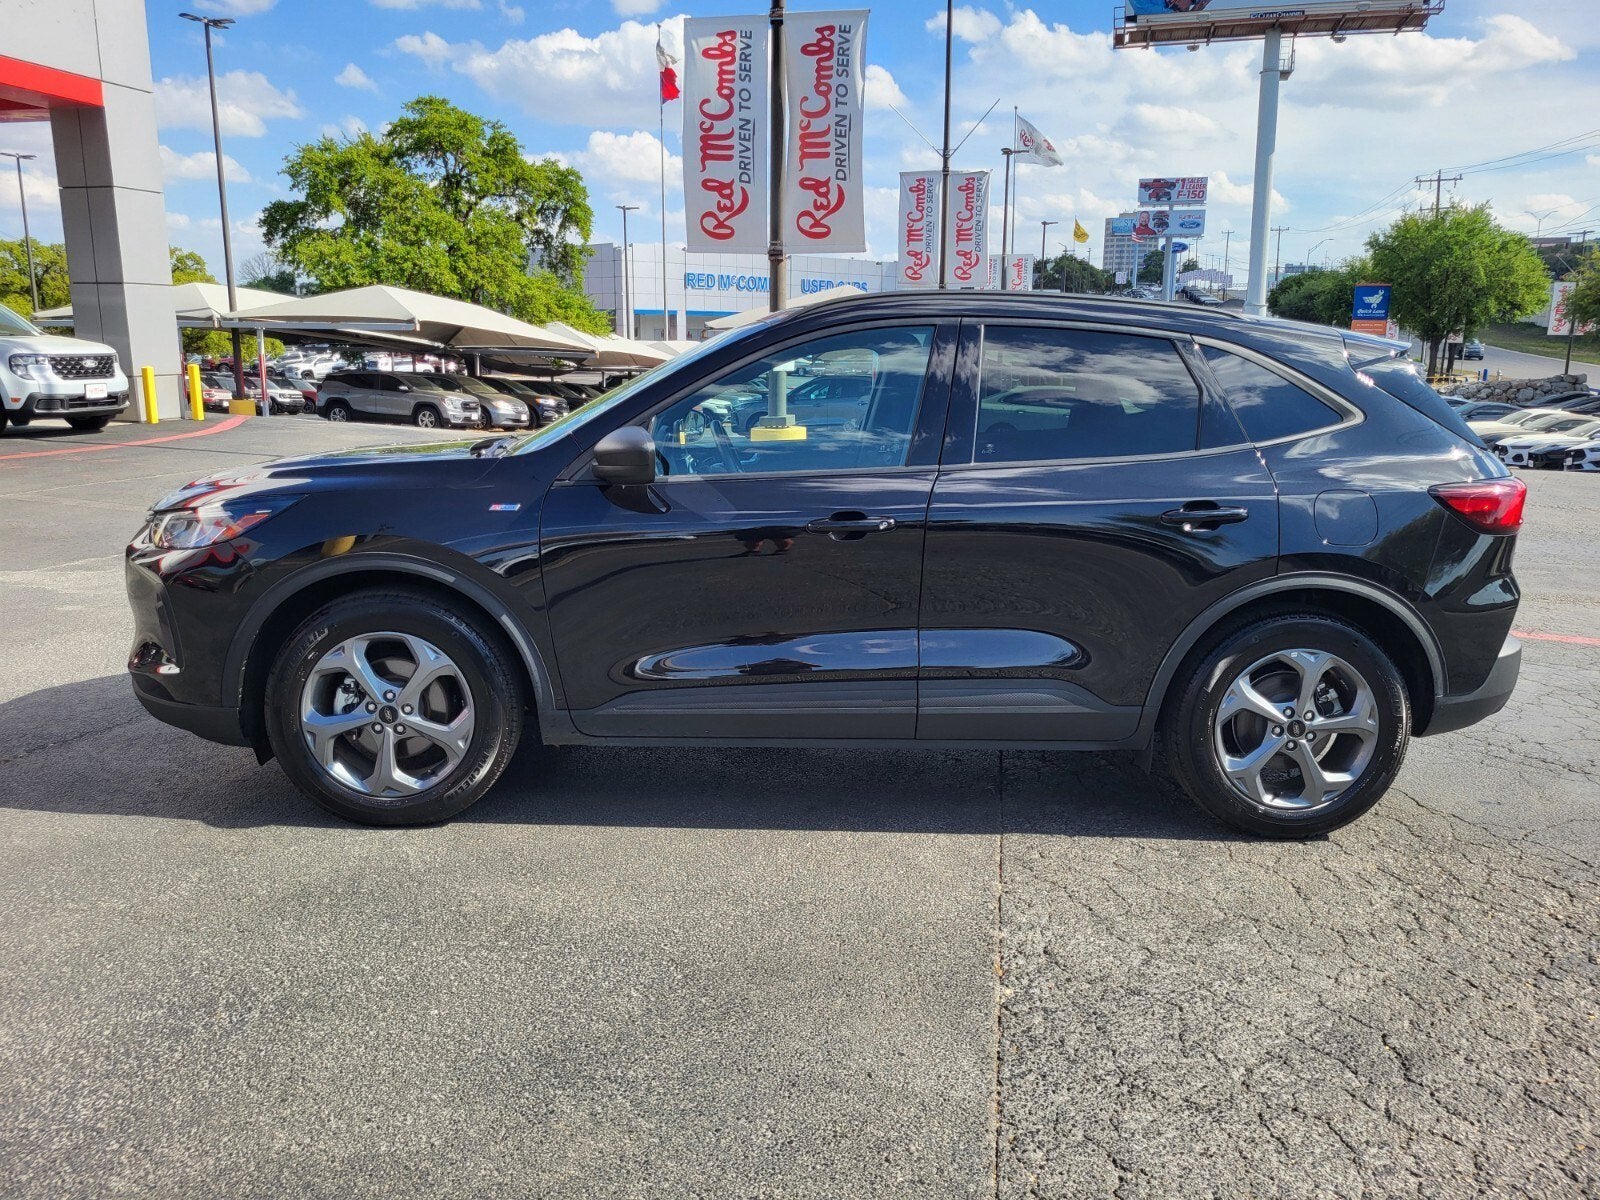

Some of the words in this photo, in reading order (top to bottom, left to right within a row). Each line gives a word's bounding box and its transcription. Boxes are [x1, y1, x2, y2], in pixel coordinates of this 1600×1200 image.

[739, 30, 753, 83] SERVE
[835, 24, 852, 78] SERVE
[699, 30, 737, 172] McCombs
[739, 88, 752, 113] TO
[799, 24, 836, 172] McCombs
[835, 83, 849, 108] TO
[738, 118, 752, 185] DRIVEN
[834, 114, 848, 182] DRIVEN
[926, 177, 935, 205] SERVE
[976, 176, 984, 205] SERVE
[1176, 190, 1205, 200] F-150
[700, 178, 749, 241] Red
[796, 176, 846, 240] Red
[906, 177, 927, 247] McCombs
[926, 205, 934, 221] TO
[956, 176, 976, 247] McCombs
[976, 205, 983, 218] TO
[925, 220, 934, 254] DRIVEN
[974, 219, 983, 253] DRIVEN
[684, 272, 716, 290] RED
[718, 274, 771, 292] McCOM
[904, 250, 931, 281] Red
[953, 250, 980, 281] Red
